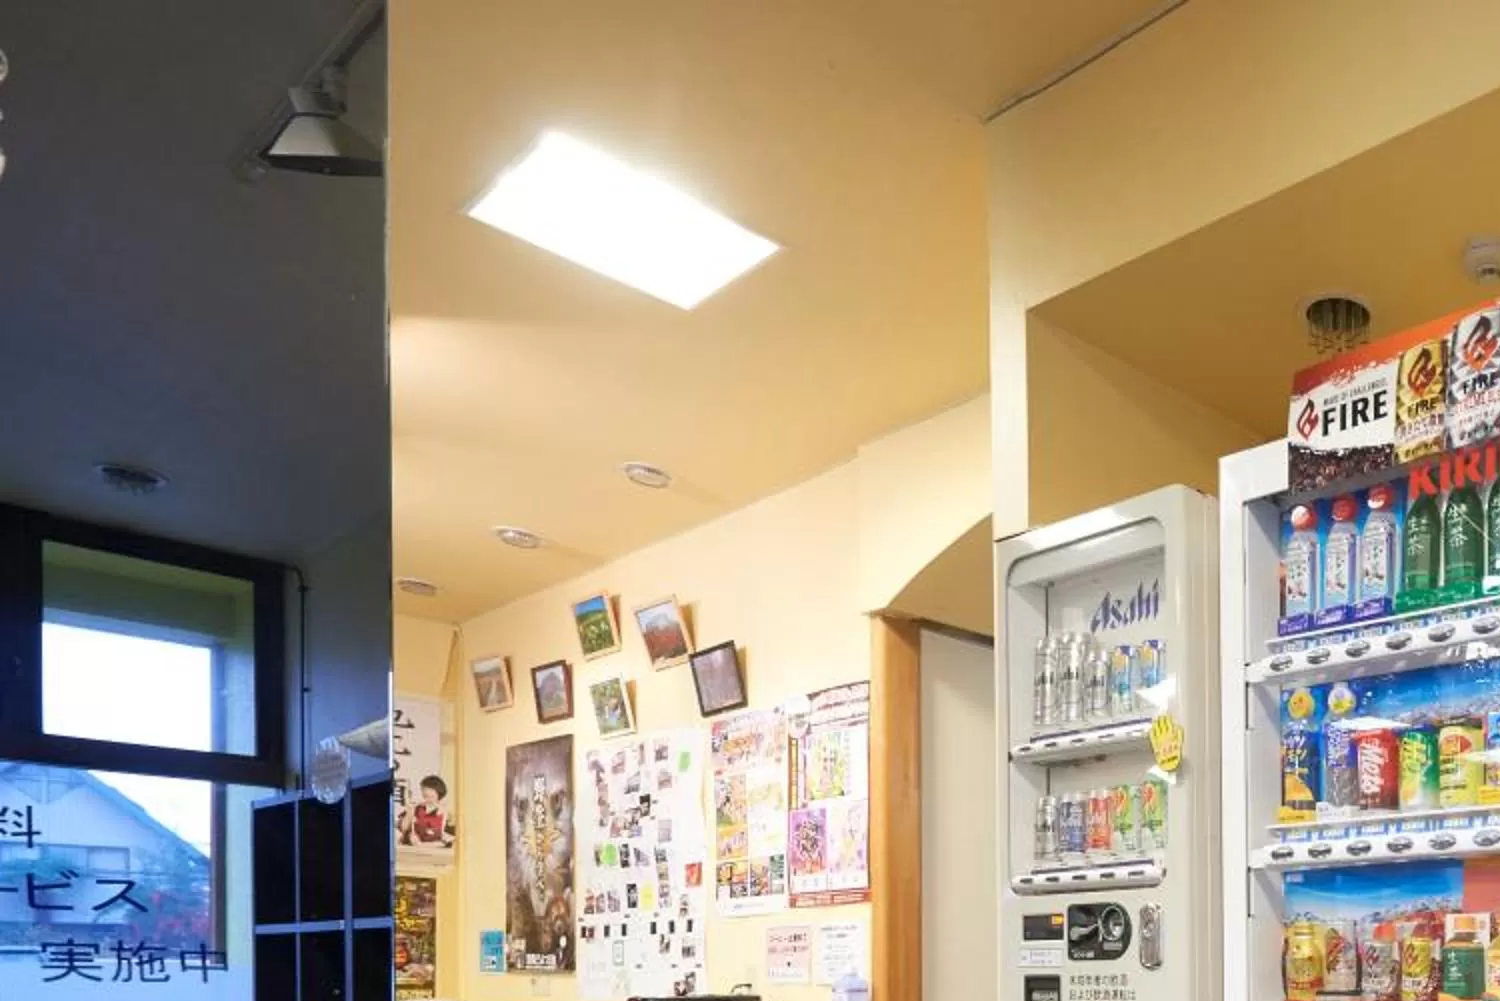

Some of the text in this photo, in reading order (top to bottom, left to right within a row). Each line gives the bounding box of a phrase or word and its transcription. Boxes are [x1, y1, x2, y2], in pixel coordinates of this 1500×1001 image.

[1322, 389, 1389, 437] FIRE
[1090, 577, 1160, 635] Asahi
[40, 937, 229, 984] 実施中
